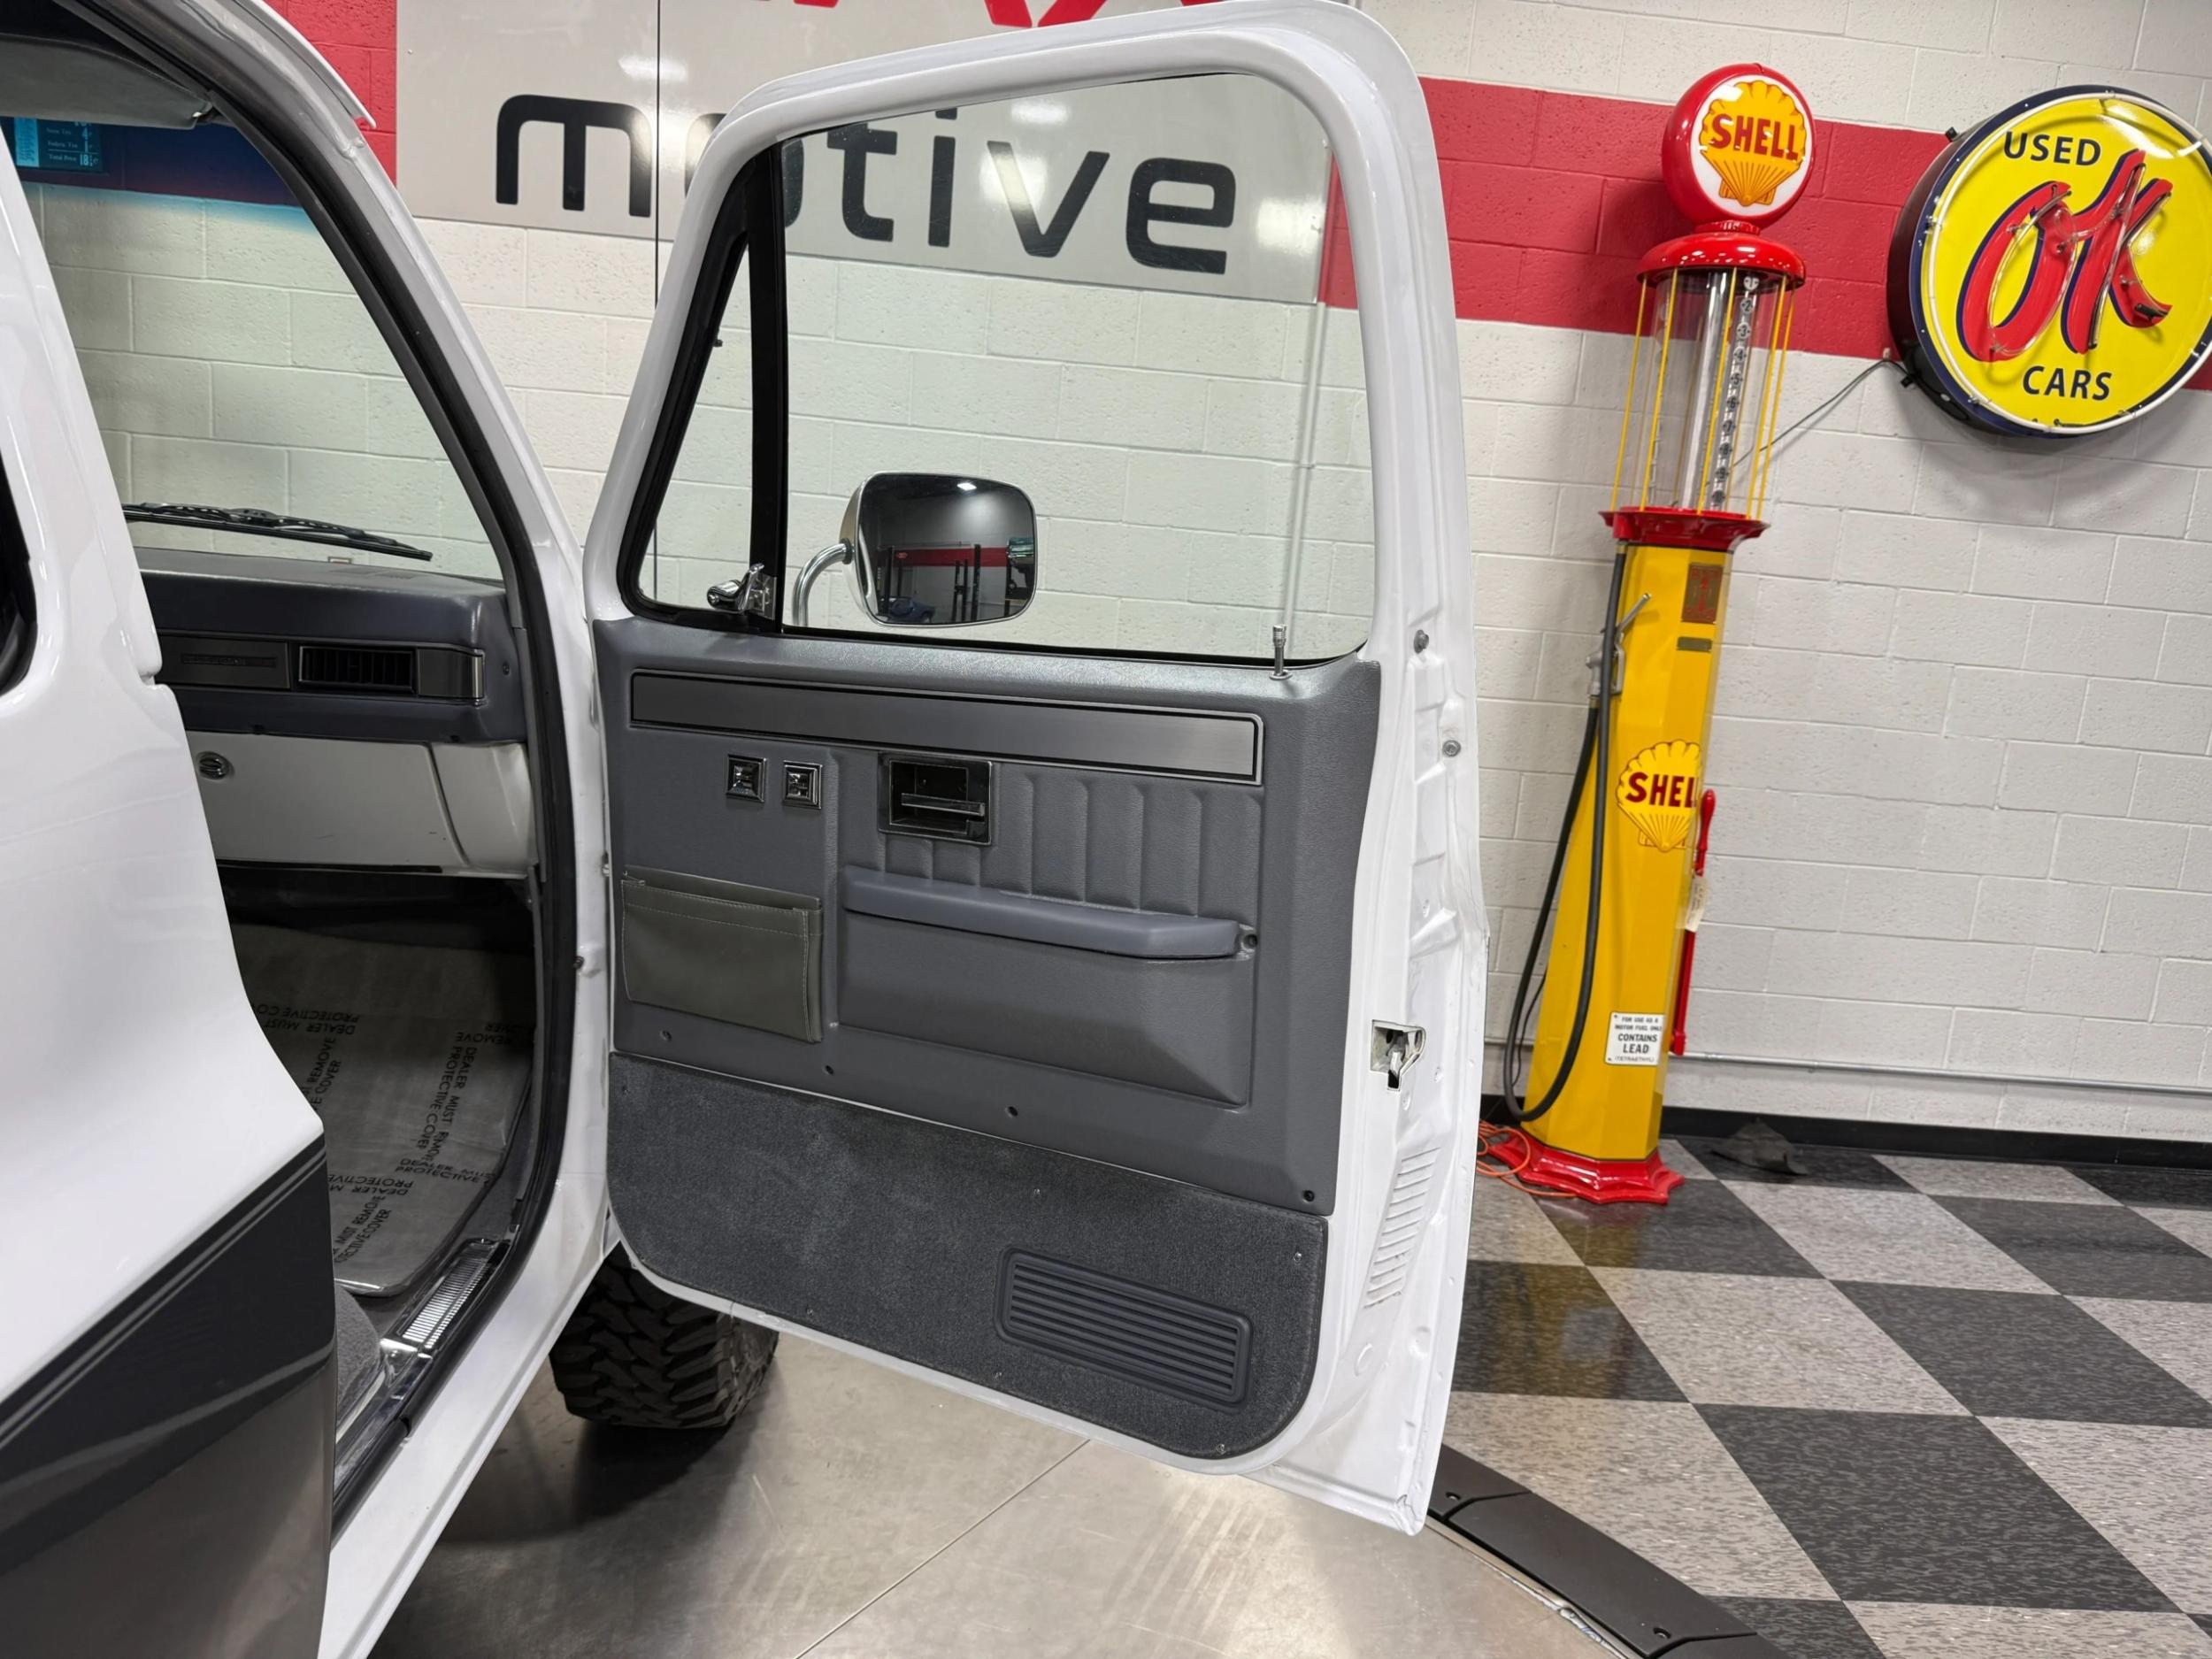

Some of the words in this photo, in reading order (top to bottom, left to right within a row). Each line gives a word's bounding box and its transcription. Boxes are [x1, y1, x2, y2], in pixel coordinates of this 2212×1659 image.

[1709, 112, 1799, 162] SHELL
[2004, 131, 2102, 167] USED
[1956, 149, 2173, 363] OK
[2023, 365, 2112, 402] CARS
[282, 1007, 361, 1023] PROTECTIVE
[306, 1022, 357, 1035] DEALER
[1617, 1033, 1658, 1043] CONTAINS
[1622, 1043, 1650, 1055] LEAD
[306, 1037, 336, 1083] REMOVE
[314, 1059, 342, 1094] COVER
[453, 1047, 478, 1090] DEALER
[428, 1046, 462, 1113] PROTECTIVE
[441, 1095, 461, 1125] MUST
[350, 1186, 410, 1196] DEALER
[395, 1166, 480, 1183] PROTECTIVE
